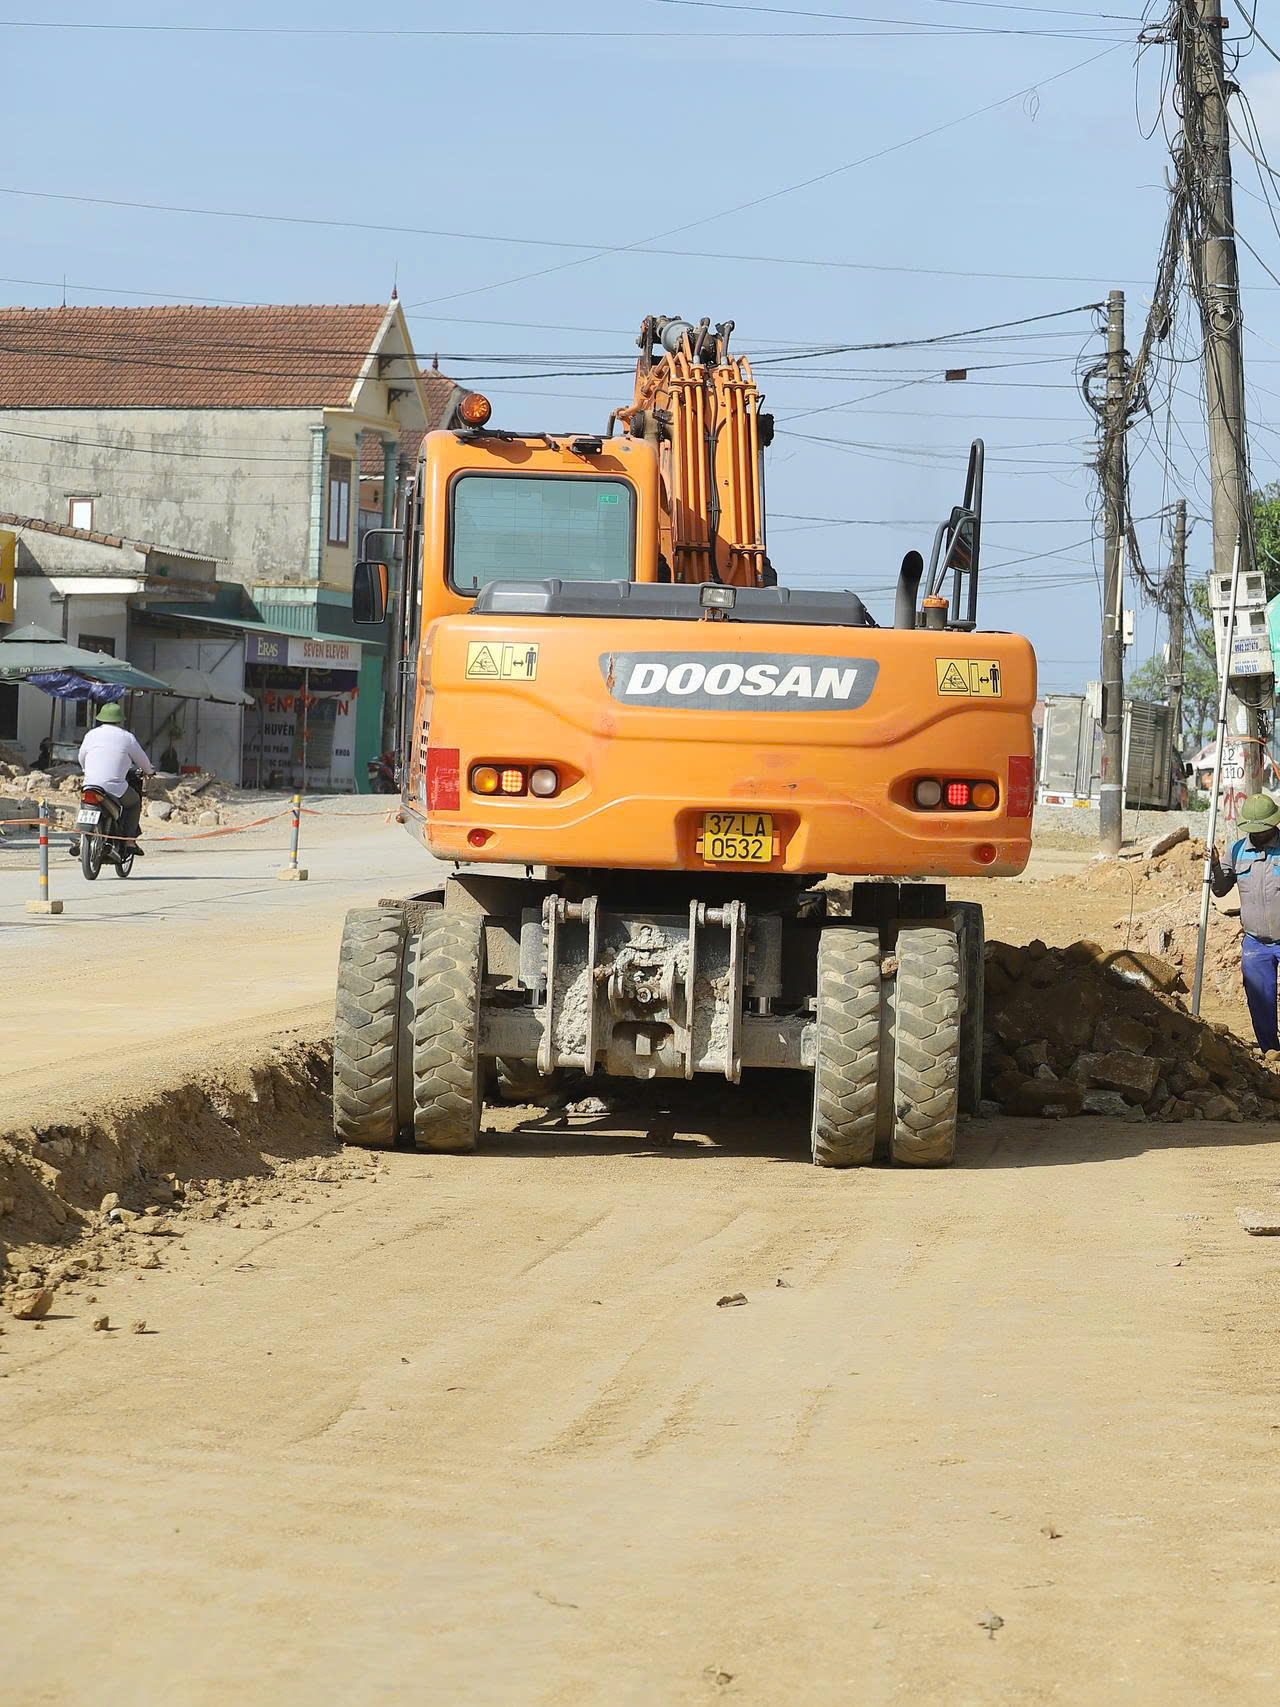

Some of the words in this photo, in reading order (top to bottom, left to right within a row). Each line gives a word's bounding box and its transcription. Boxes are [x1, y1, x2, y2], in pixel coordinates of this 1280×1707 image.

[303, 642, 324, 659] SEVEN
[325, 644, 350, 661] ELEVEN
[625, 662, 858, 700] DOOSAN
[709, 814, 766, 837] 37-LA
[712, 837, 763, 859] 0532
